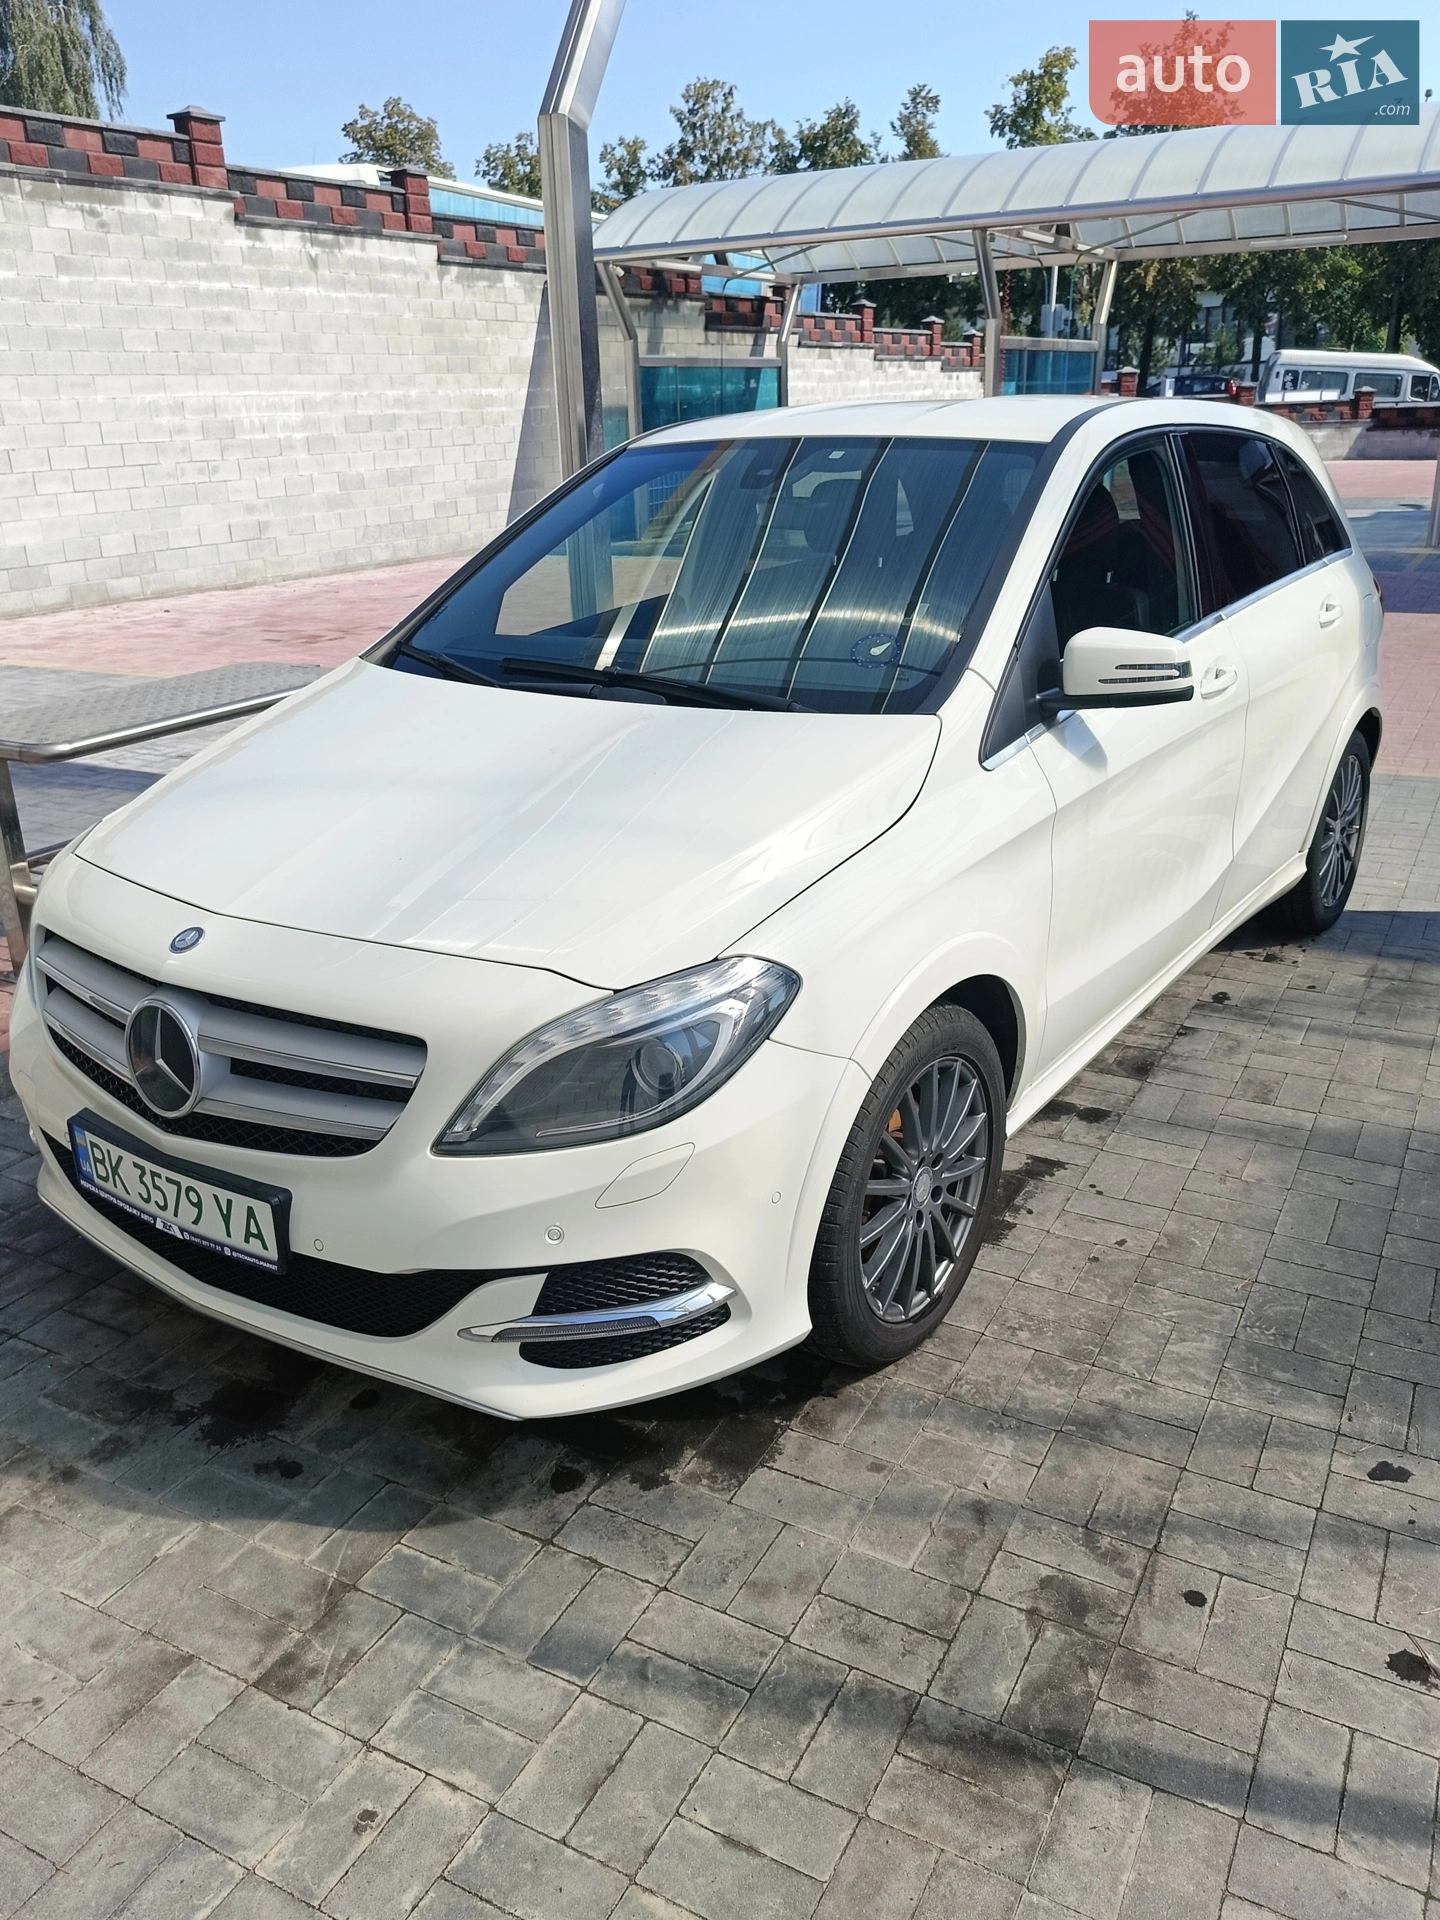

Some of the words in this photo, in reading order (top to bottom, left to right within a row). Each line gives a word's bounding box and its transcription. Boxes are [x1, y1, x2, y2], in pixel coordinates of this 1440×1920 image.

[80, 1158, 93, 1175] UA
[89, 1139, 131, 1196] BK
[132, 1161, 204, 1225] 3579
[213, 1194, 269, 1251] YA
